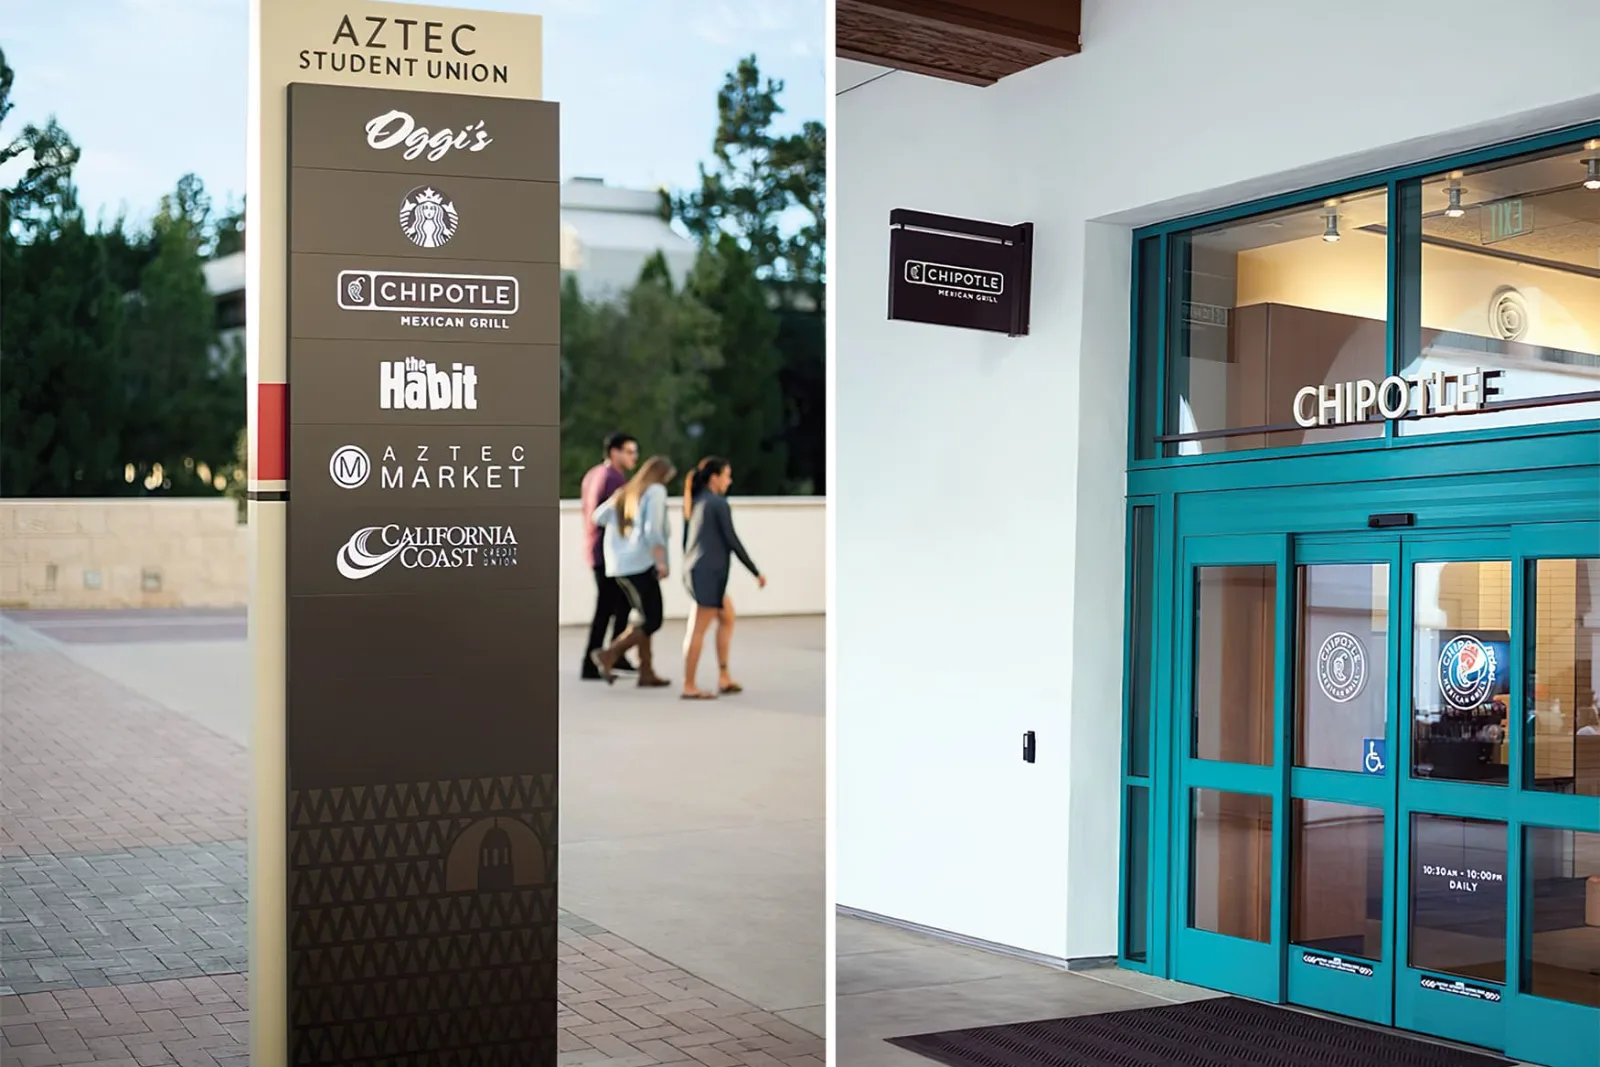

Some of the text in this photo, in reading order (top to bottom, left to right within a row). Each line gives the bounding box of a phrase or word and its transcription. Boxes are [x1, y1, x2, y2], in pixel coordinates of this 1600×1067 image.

[332, 14, 477, 56] AZTEC
[299, 50, 508, 83] STUDENT UNION
[364, 109, 493, 162] Oggi's
[928, 268, 999, 289] CHIPOTLE
[380, 281, 510, 305] CHIPOTLE
[938, 289, 998, 304] MEXICAN GRILL
[400, 315, 510, 329] MEXICAN GRILL
[405, 356, 426, 371] the
[380, 361, 477, 410] Habit
[382, 445, 525, 461] AZTEC
[381, 465, 526, 488] MARKET
[381, 524, 518, 547] CALIFORNIA
[400, 547, 478, 569] COAST
[483, 547, 518, 557] CREDIT
[483, 557, 518, 567] UNION
[1321, 635, 1361, 663] CHIPOTLE
[1443, 678, 1470, 704] MEXICAN
[1423, 865, 1458, 877] 10:30AM
[1466, 869, 1503, 881] 10:00PM
[1449, 880, 1478, 892] DAILY
